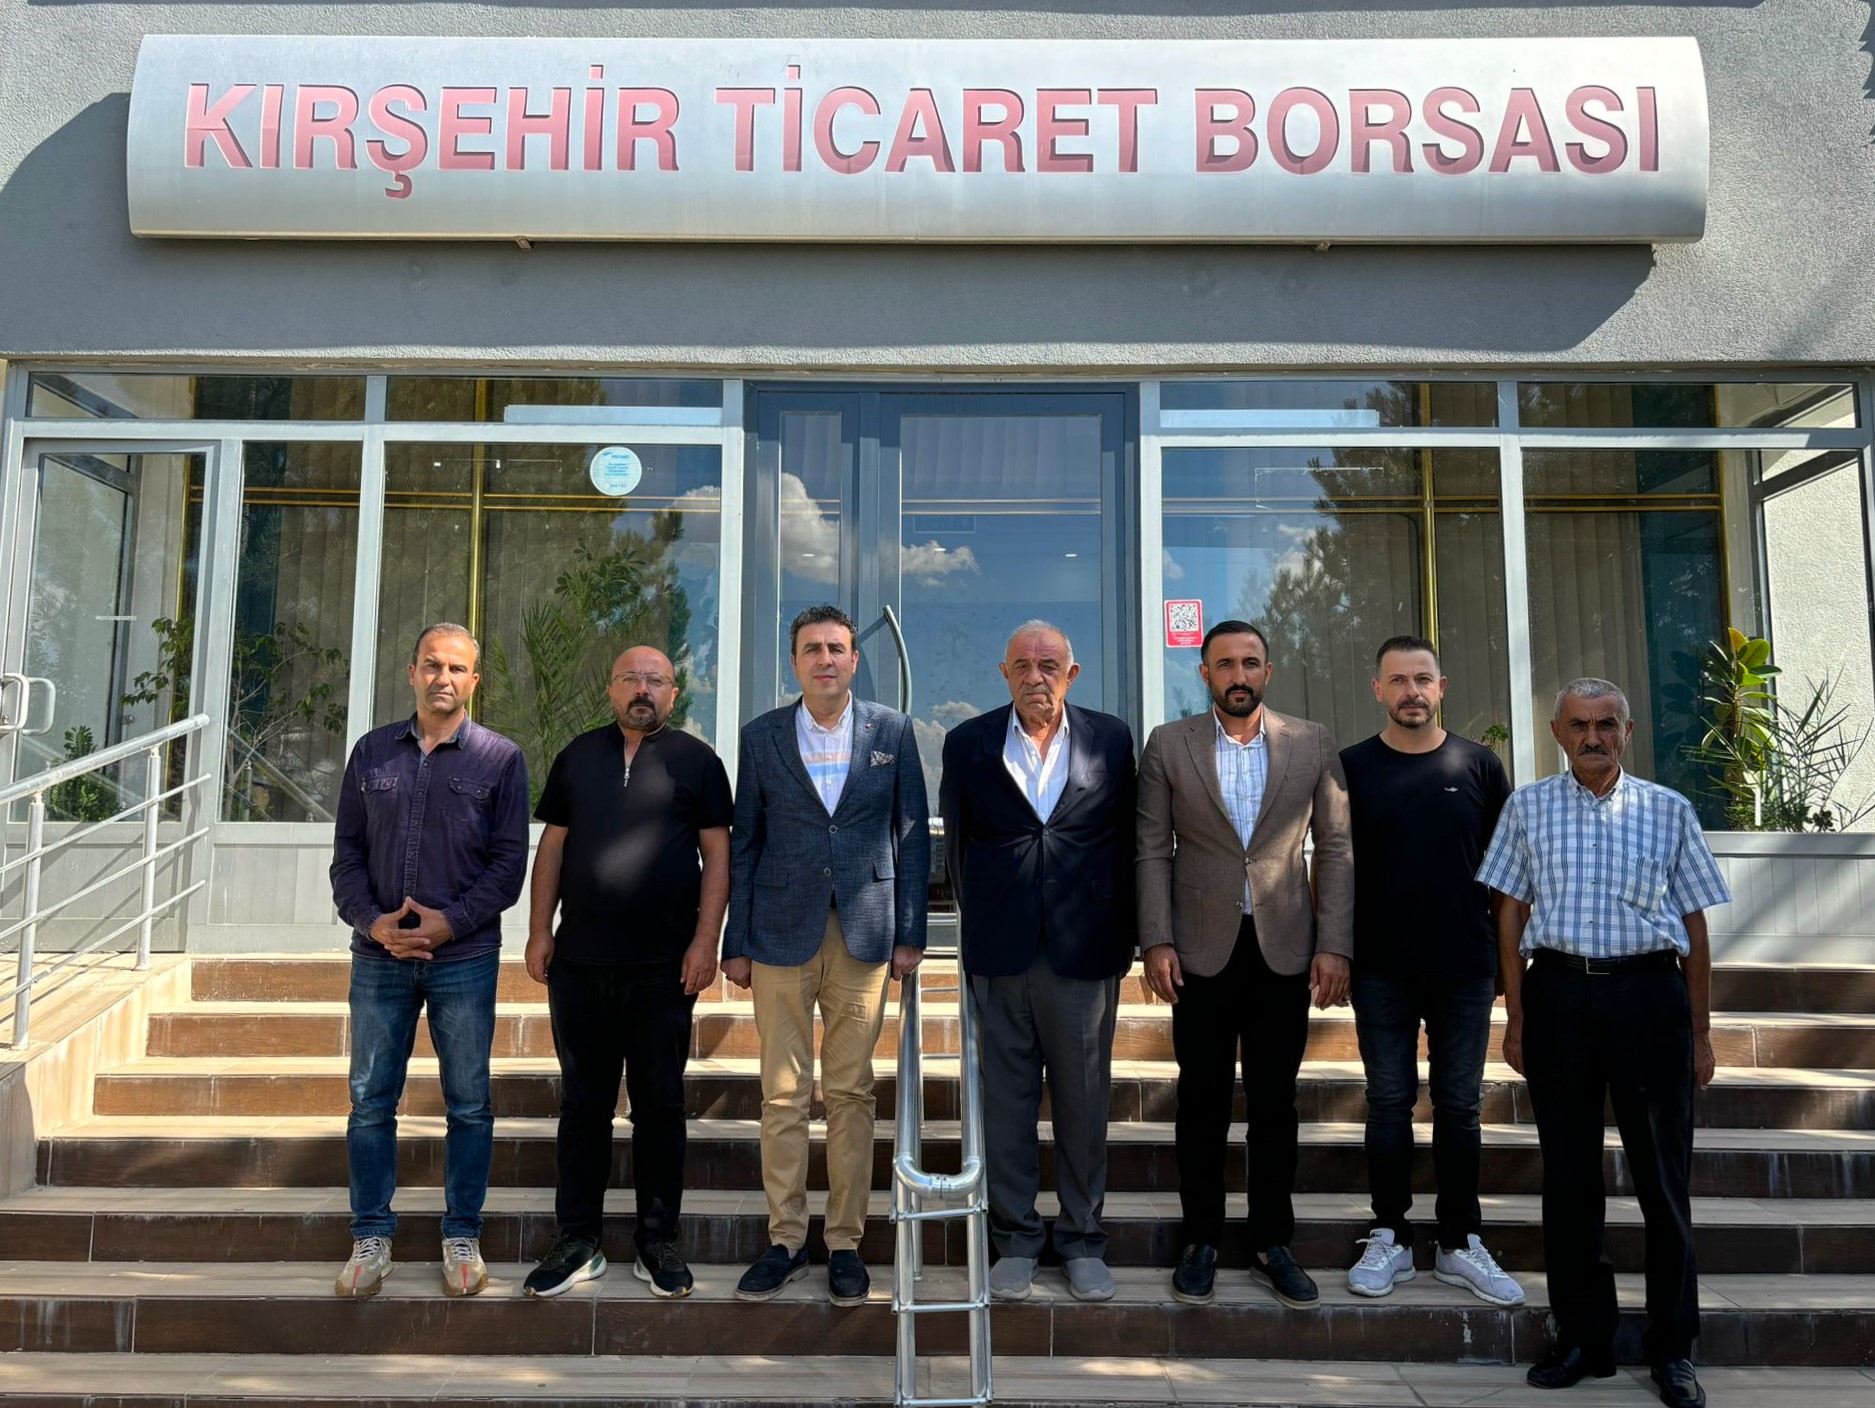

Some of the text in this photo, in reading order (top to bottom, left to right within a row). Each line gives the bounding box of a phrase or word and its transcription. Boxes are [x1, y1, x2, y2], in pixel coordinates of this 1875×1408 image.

[184, 64, 1661, 200] KIRŞEHİR TİCARET BORSASI
